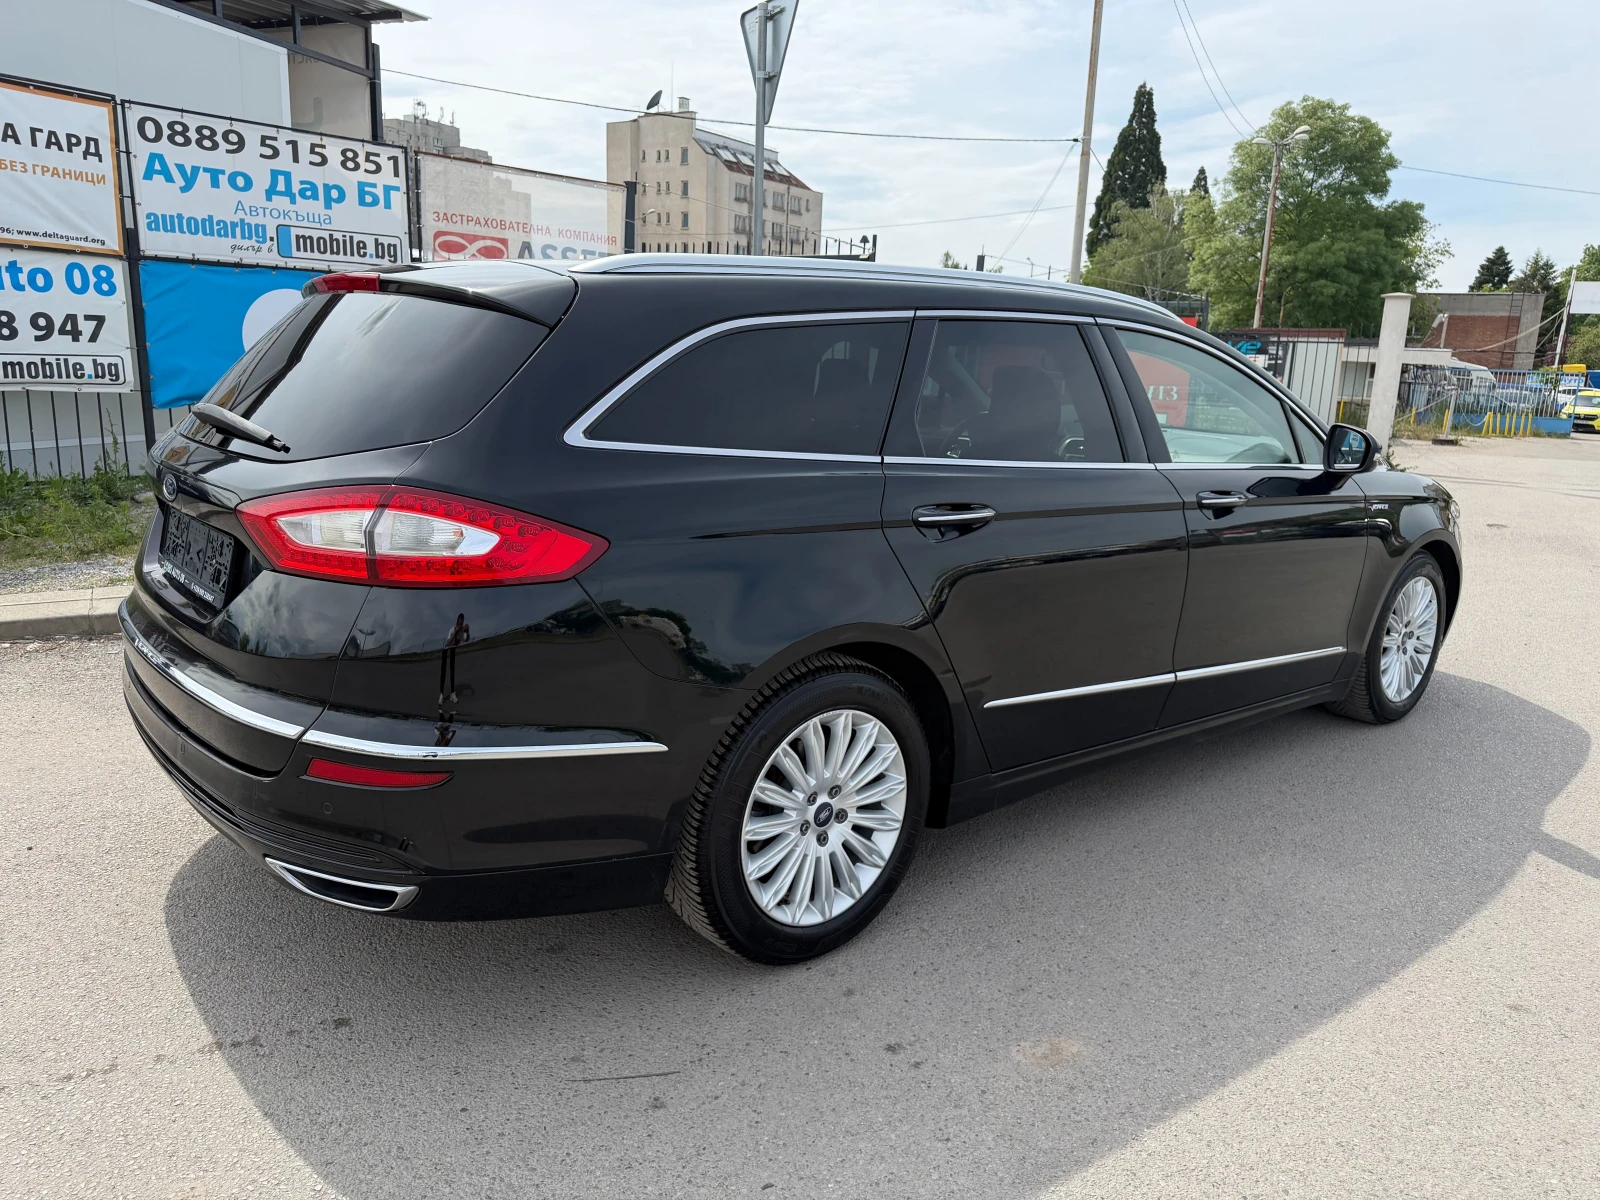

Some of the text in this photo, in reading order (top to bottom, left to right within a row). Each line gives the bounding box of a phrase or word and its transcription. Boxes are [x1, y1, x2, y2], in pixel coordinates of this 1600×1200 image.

[29, 126, 103, 163] ГАРД
[137, 116, 400, 177] 0889 515 851
[0, 158, 106, 186] БЕЗ ГРАНИЦИ
[142, 152, 400, 210] Ауто Дар БГ
[234, 200, 332, 227] Автокъща
[433, 211, 617, 246] ЗАСТРАХОВАТЕЛНА КОМПАНИЯ
[16, 229, 106, 246] www.deltaguard.org
[295, 233, 398, 264] mobile.bg
[0, 259, 118, 297] to 08
[0, 310, 106, 343] 8 947
[2, 358, 121, 382] mobile.bg
